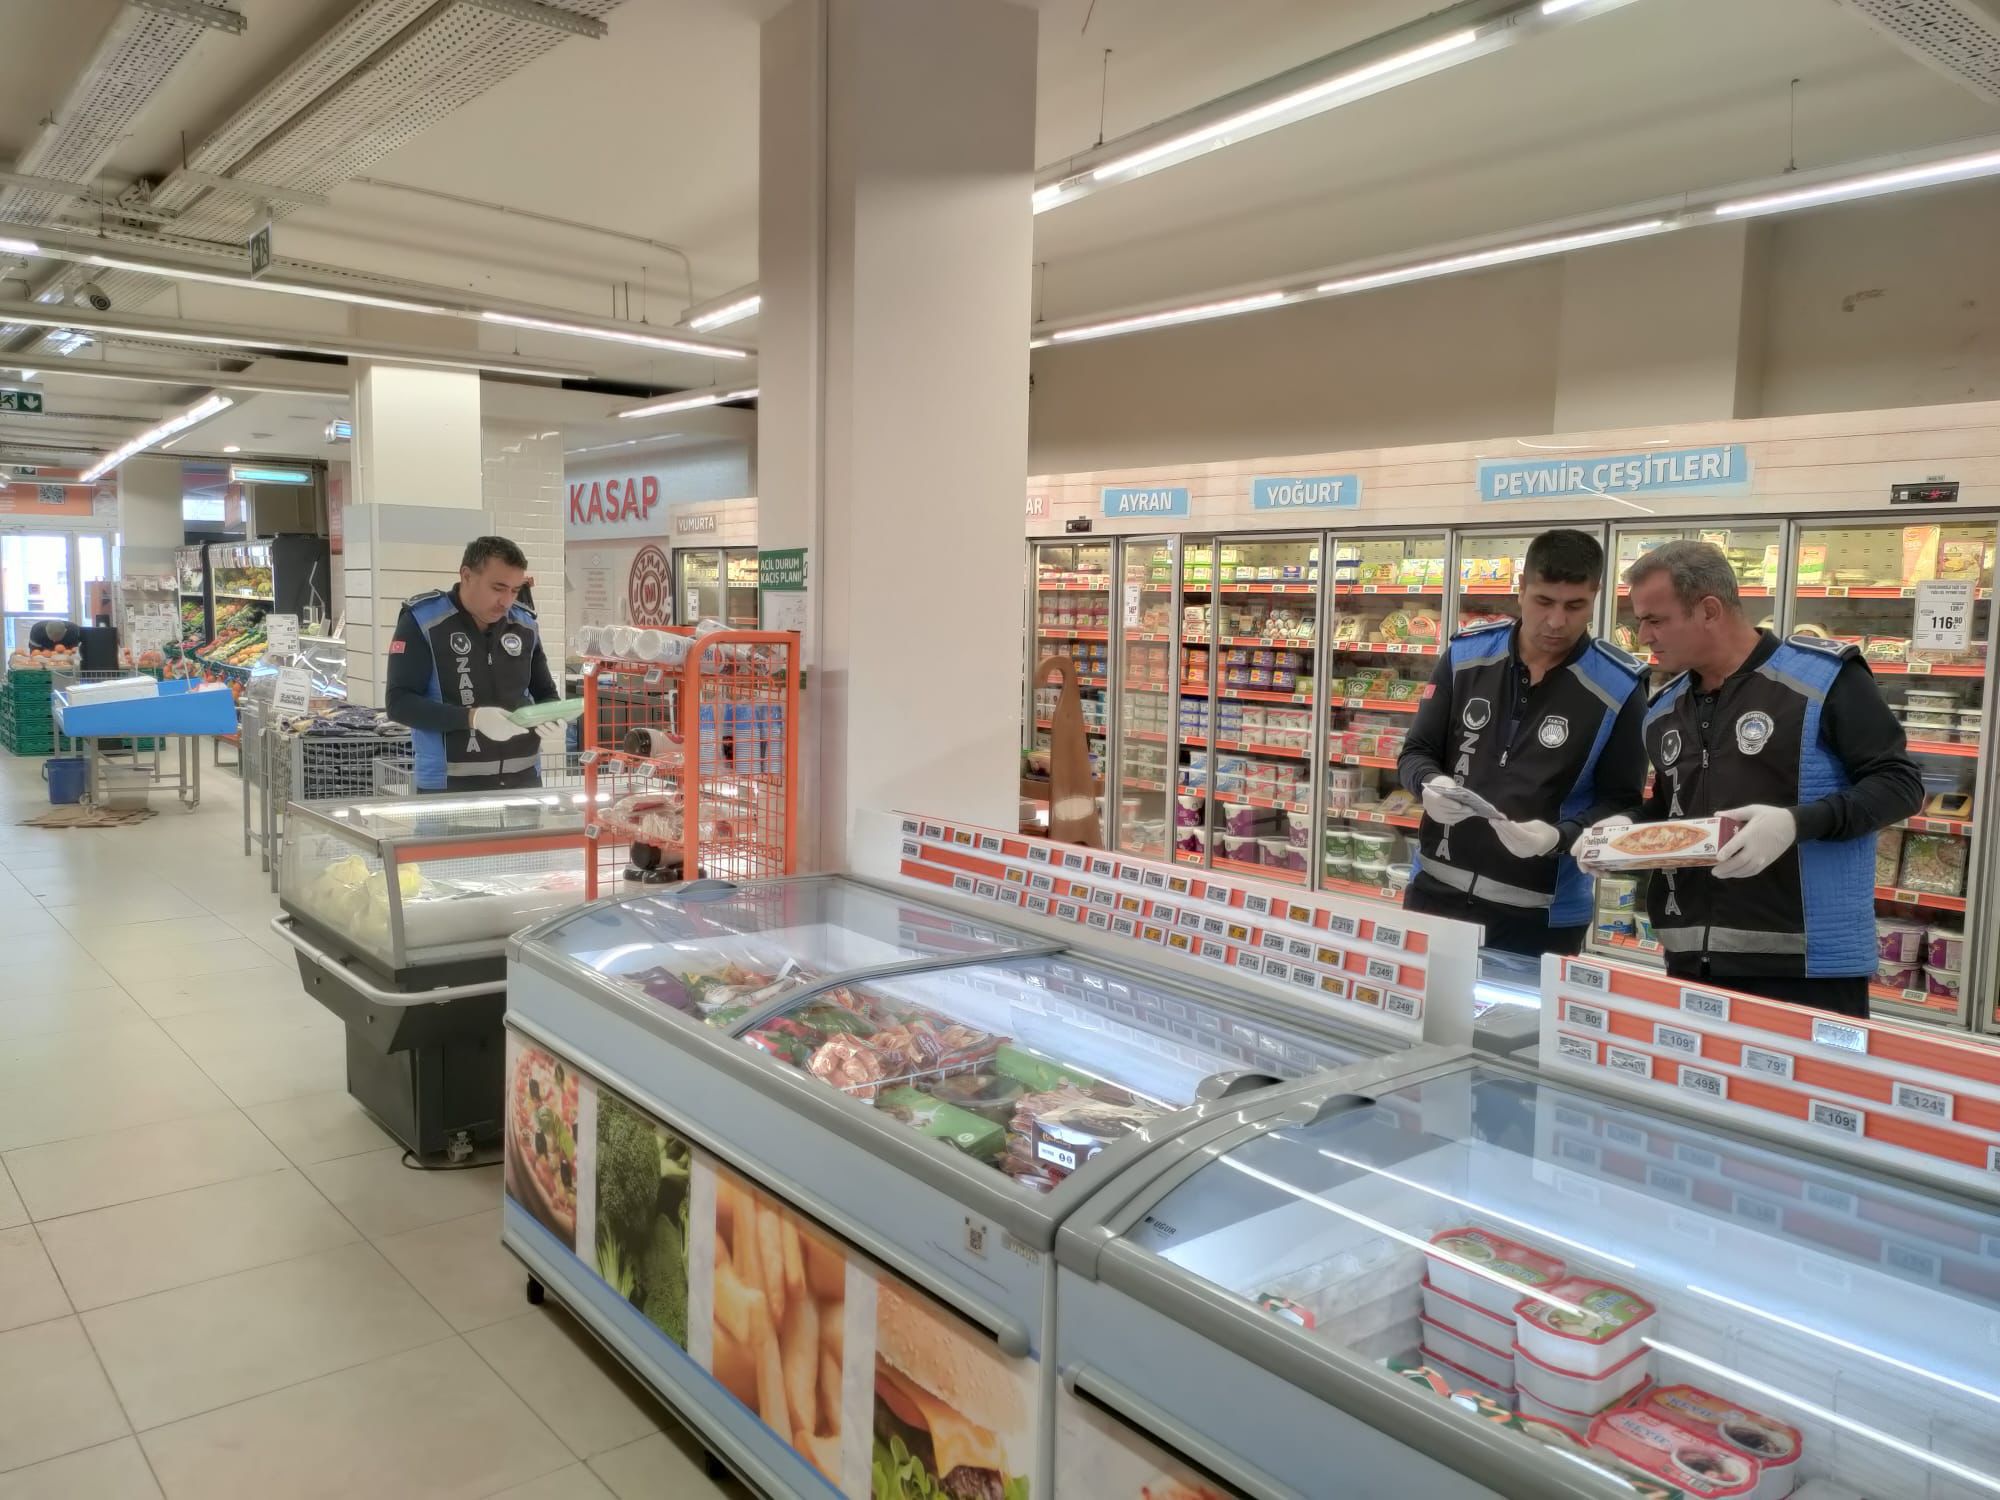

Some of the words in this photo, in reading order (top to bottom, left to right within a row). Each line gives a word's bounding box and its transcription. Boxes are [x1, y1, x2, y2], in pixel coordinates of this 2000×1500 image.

[1493, 462, 1584, 497] PEYNİR
[1592, 445, 1733, 493] ÇEŞİTLERİ
[570, 475, 659, 525] KASAP
[1119, 490, 1172, 512] AYRAN
[1266, 480, 1343, 506] YOĞURT
[1025, 497, 1043, 515] AR
[678, 516, 714, 532] YUMURTA
[634, 554, 667, 583] UZMAN
[761, 557, 775, 571] ACİL
[775, 557, 800, 570] DURUM
[760, 571, 780, 585] KAÇIŞ
